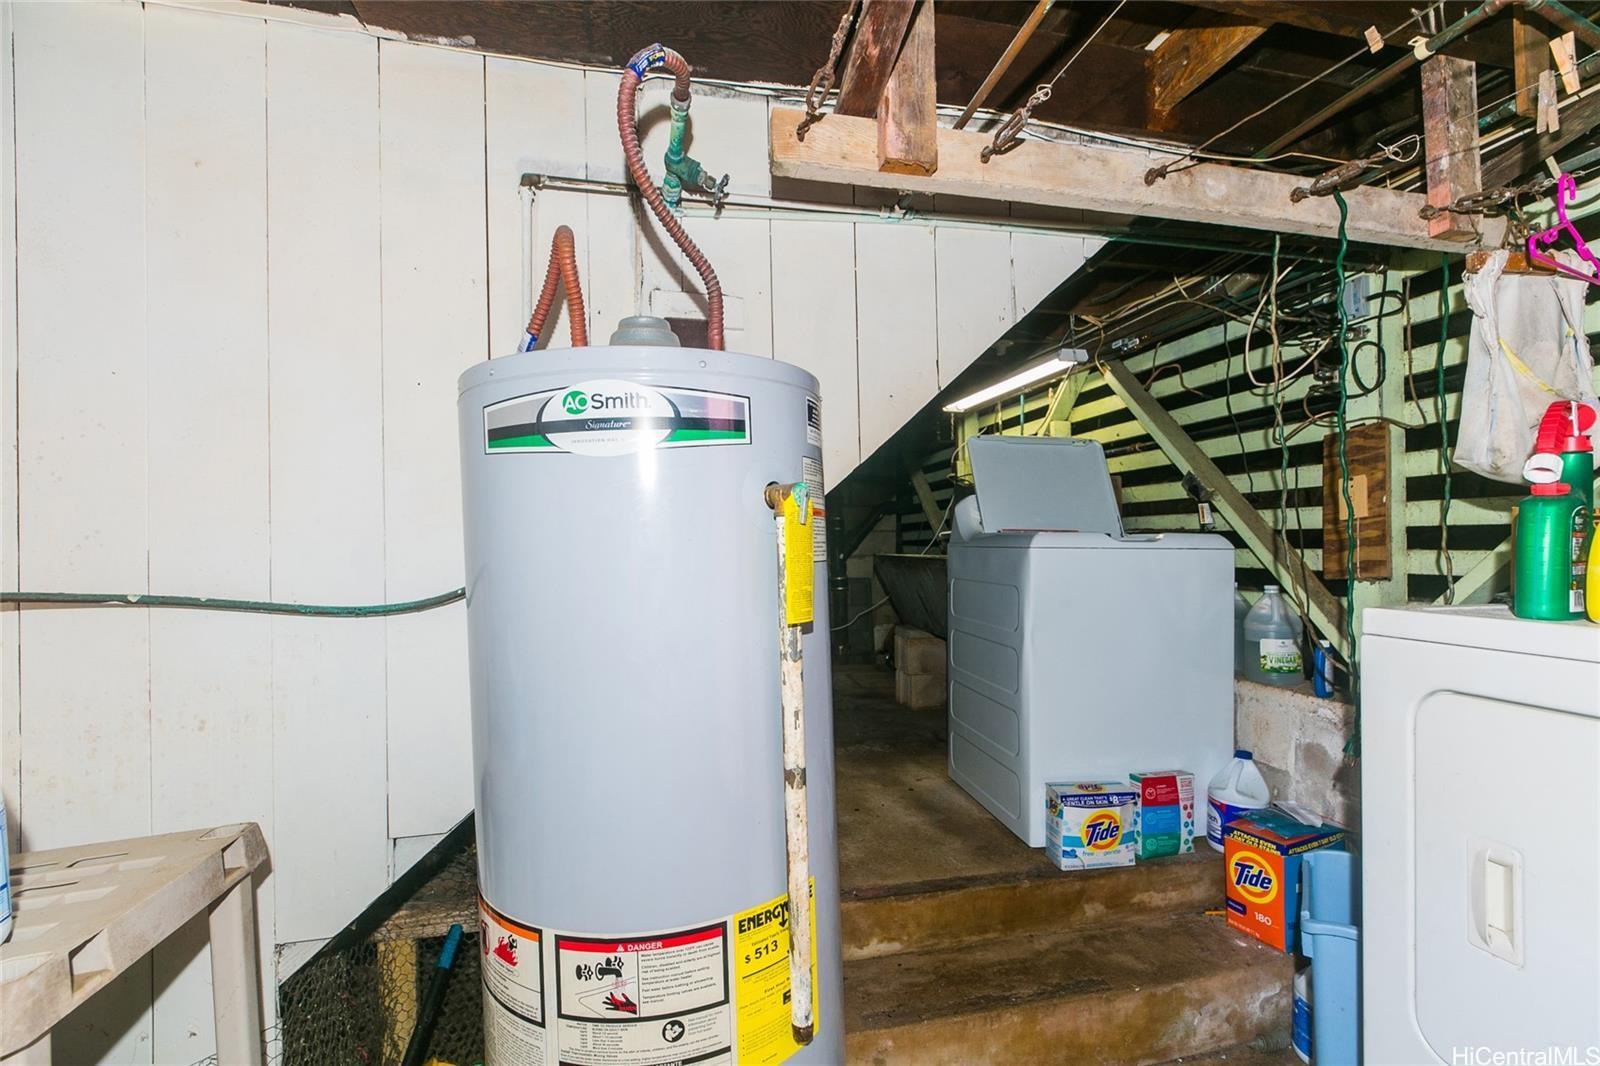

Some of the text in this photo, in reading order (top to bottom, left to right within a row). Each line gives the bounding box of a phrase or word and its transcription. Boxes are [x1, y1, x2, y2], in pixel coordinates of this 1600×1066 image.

[1086, 820, 1120, 847] Tide
[1234, 861, 1273, 890] Tide
[1254, 911, 1272, 926] 180
[627, 942, 663, 951] DANGER
[754, 940, 778, 960] 513
